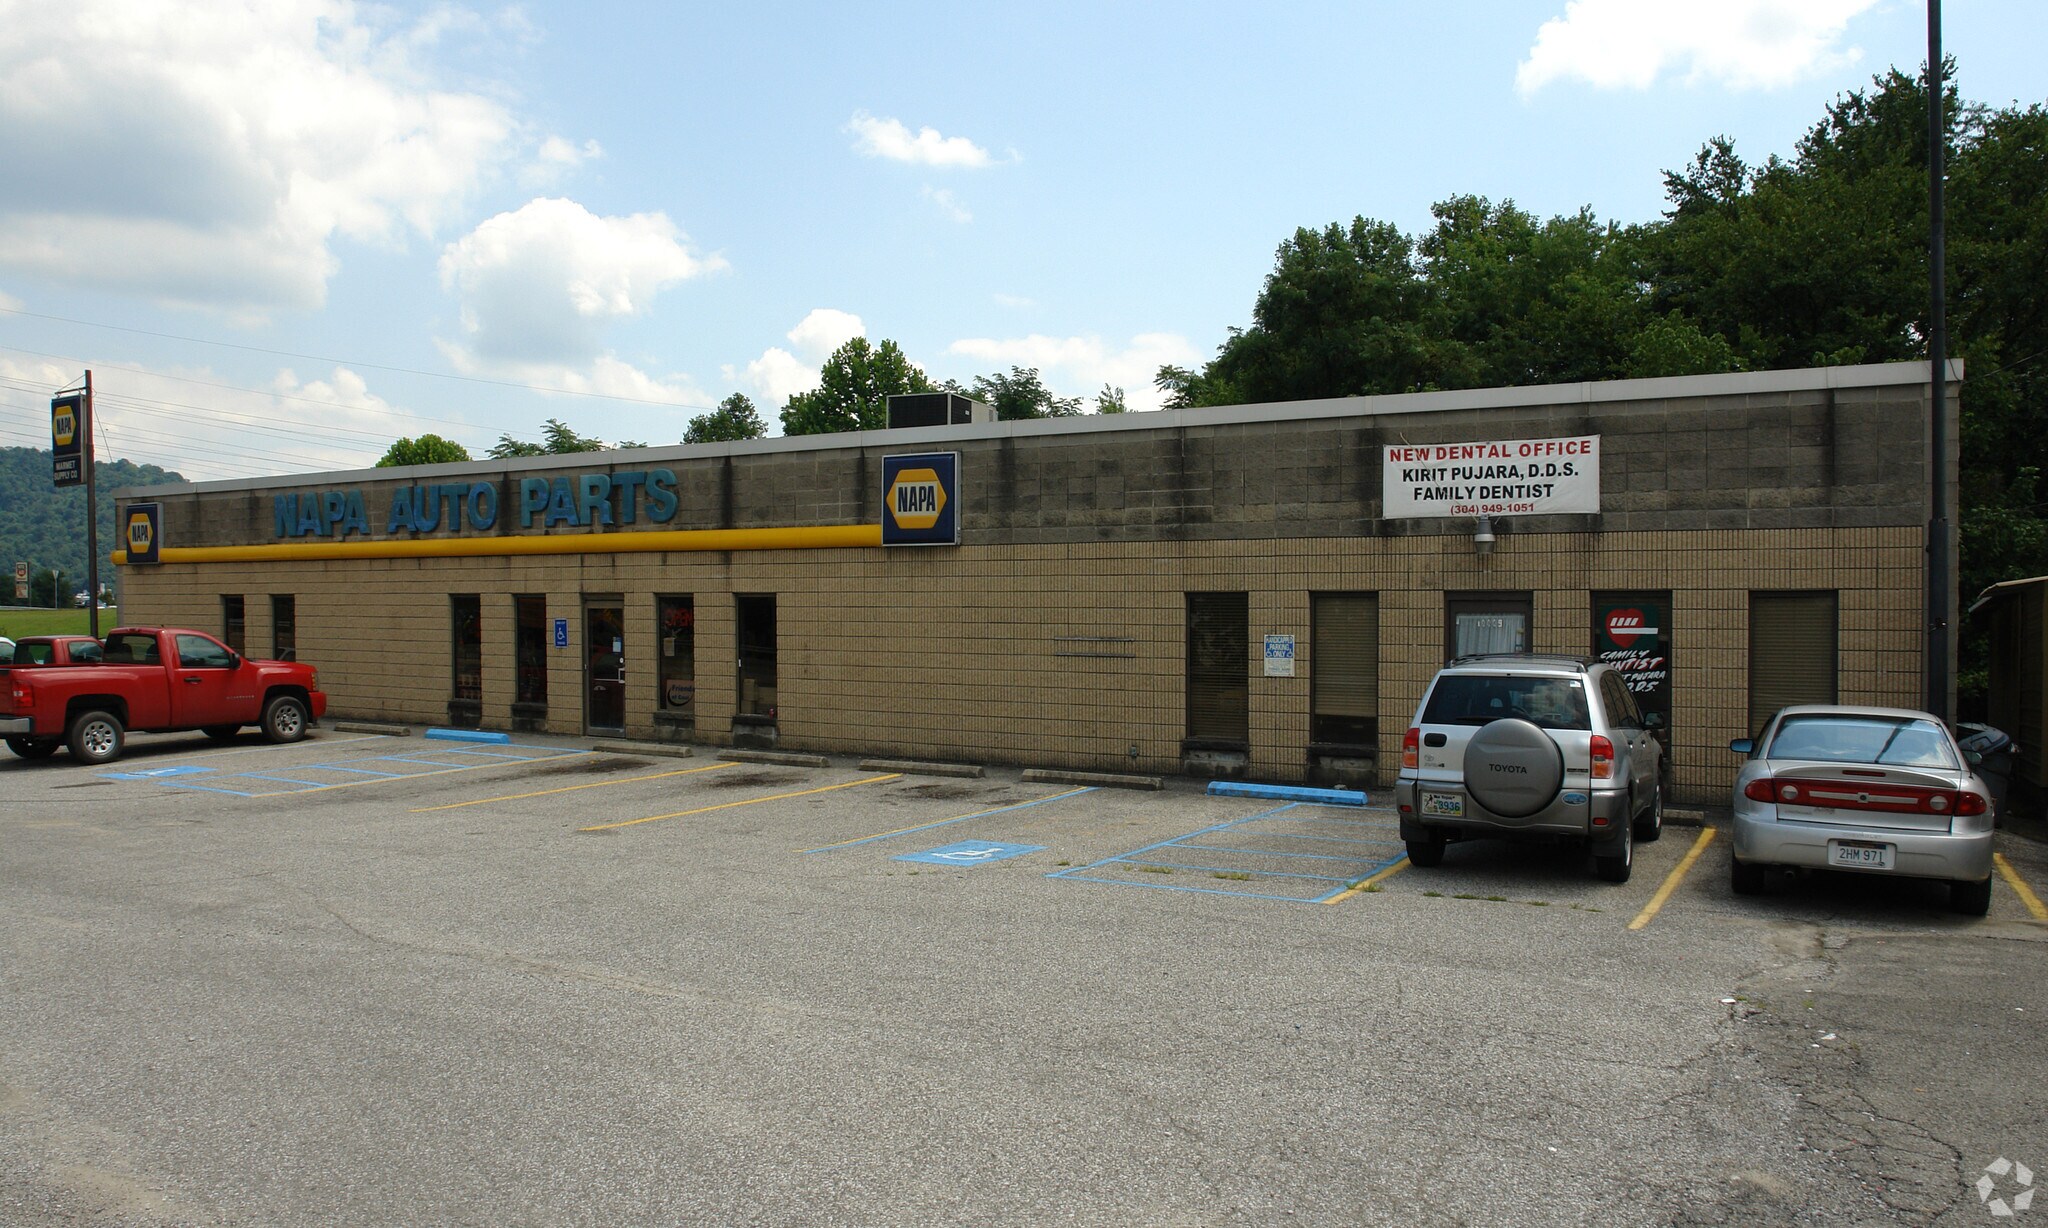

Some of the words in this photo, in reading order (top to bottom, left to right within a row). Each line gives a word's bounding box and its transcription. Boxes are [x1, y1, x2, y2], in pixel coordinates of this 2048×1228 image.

[56, 417, 72, 435] NAPA
[1389, 447, 1430, 462] NEW
[1436, 444, 1511, 461] DENTAL
[1519, 440, 1591, 457] OFFICE
[1402, 467, 1447, 482] KIRIT
[1451, 464, 1524, 481] PUJARA,
[1528, 462, 1579, 478] D.D.S.
[897, 485, 936, 513] NAPA
[1413, 486, 1476, 501] FAMILY
[1479, 483, 1554, 500] DENTIST
[273, 488, 370, 538] NAPA
[387, 480, 498, 533] AUTO
[520, 468, 680, 529] PARTS
[1450, 504, 1479, 515] (304)
[1482, 503, 1535, 514] 949-1051
[132, 524, 149, 542] NAPA
[1273, 650, 1286, 658] ONLY
[1630, 670, 1666, 681] PUJARA
[1489, 763, 1527, 774] TOYOTA
[1839, 848, 1860, 860] 2HM
[1863, 850, 1882, 862] 971
